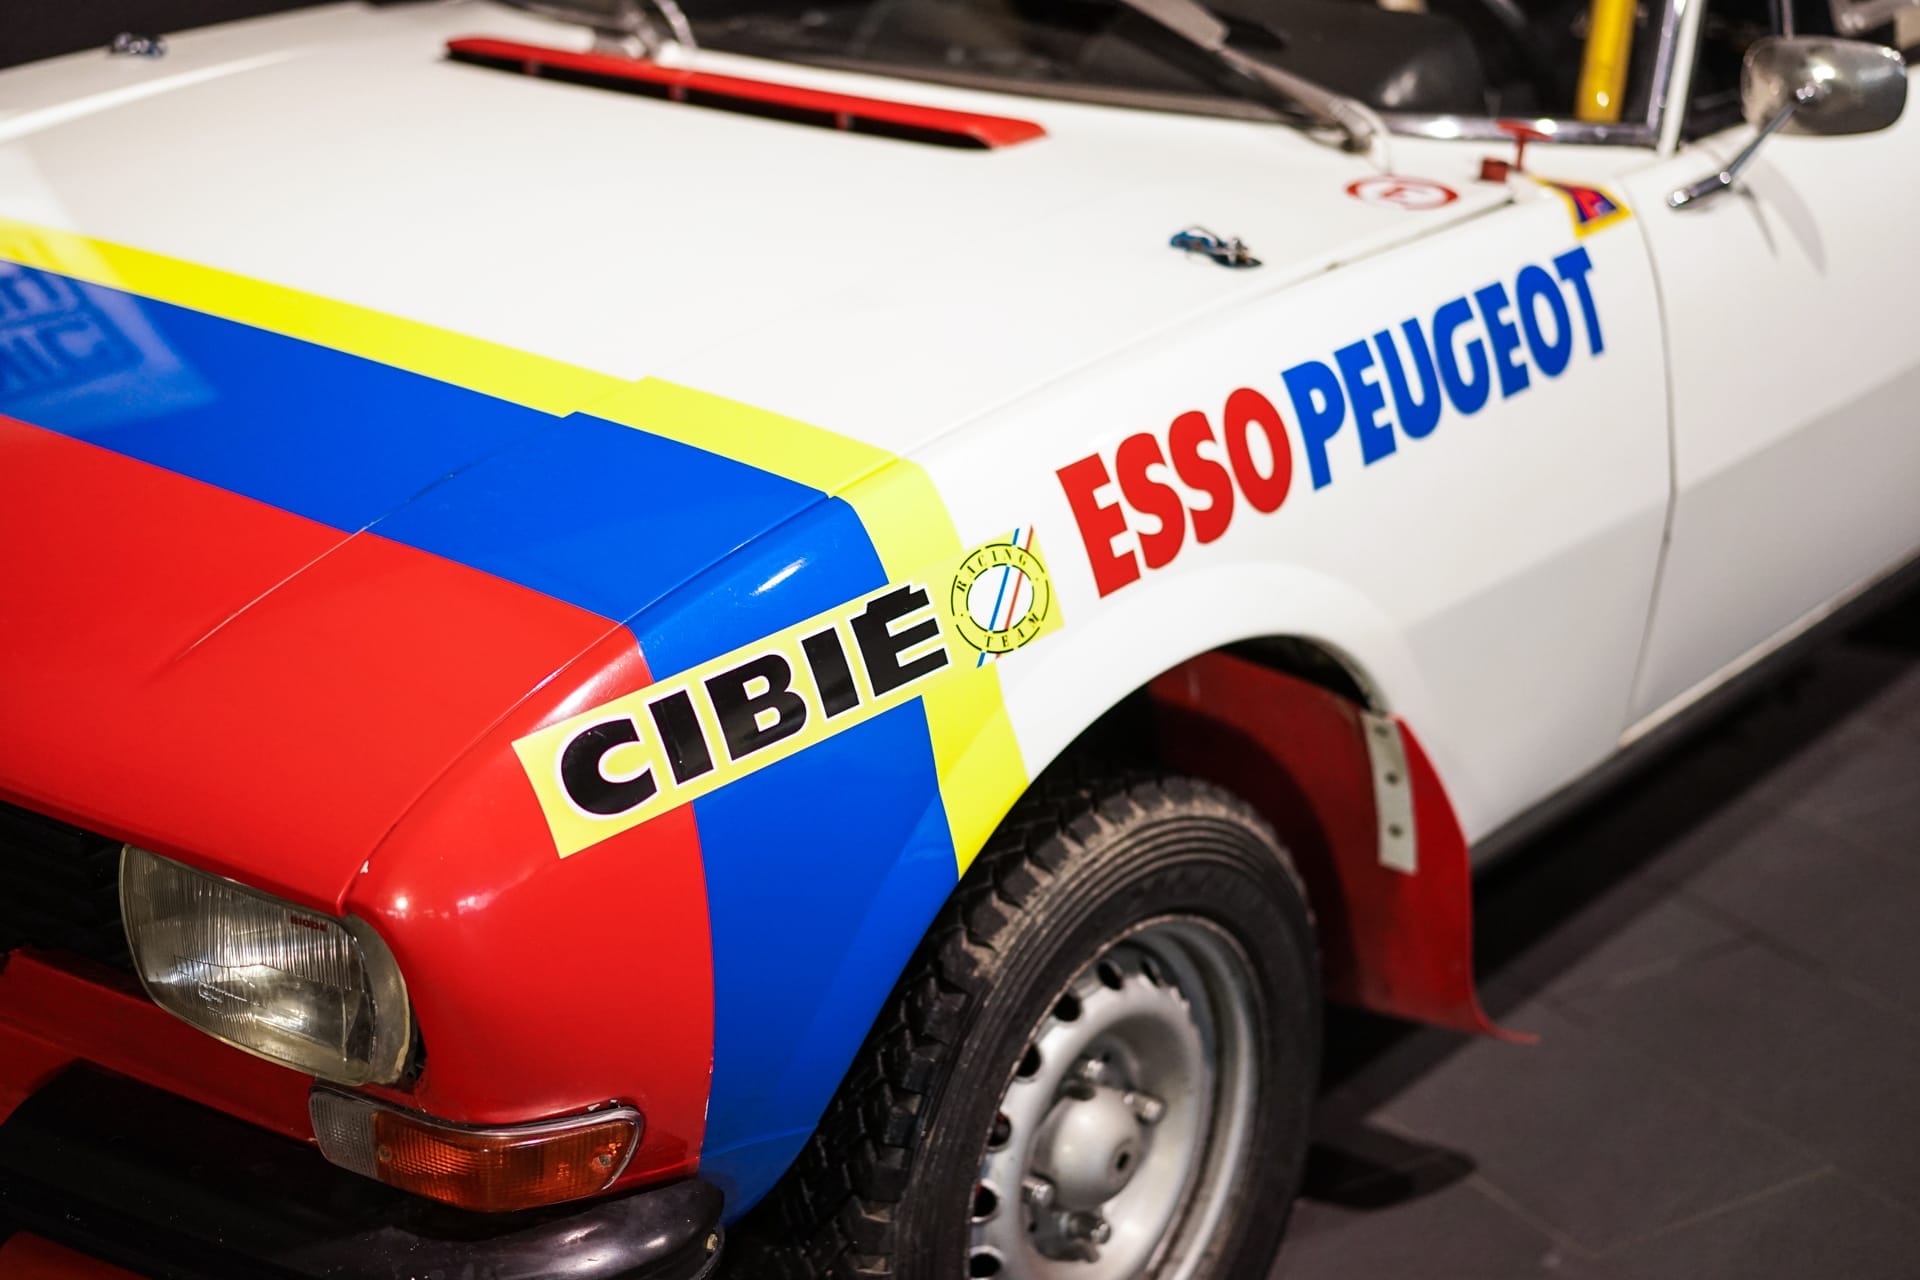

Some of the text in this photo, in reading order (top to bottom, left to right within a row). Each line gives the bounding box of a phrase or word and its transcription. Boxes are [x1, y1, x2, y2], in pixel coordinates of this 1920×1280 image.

[1056, 246, 1605, 598] ESSO PEUGEOT
[956, 548, 1028, 592] RACING
[984, 613, 1040, 648] TEAM
[561, 584, 950, 815] CIBIÉ
